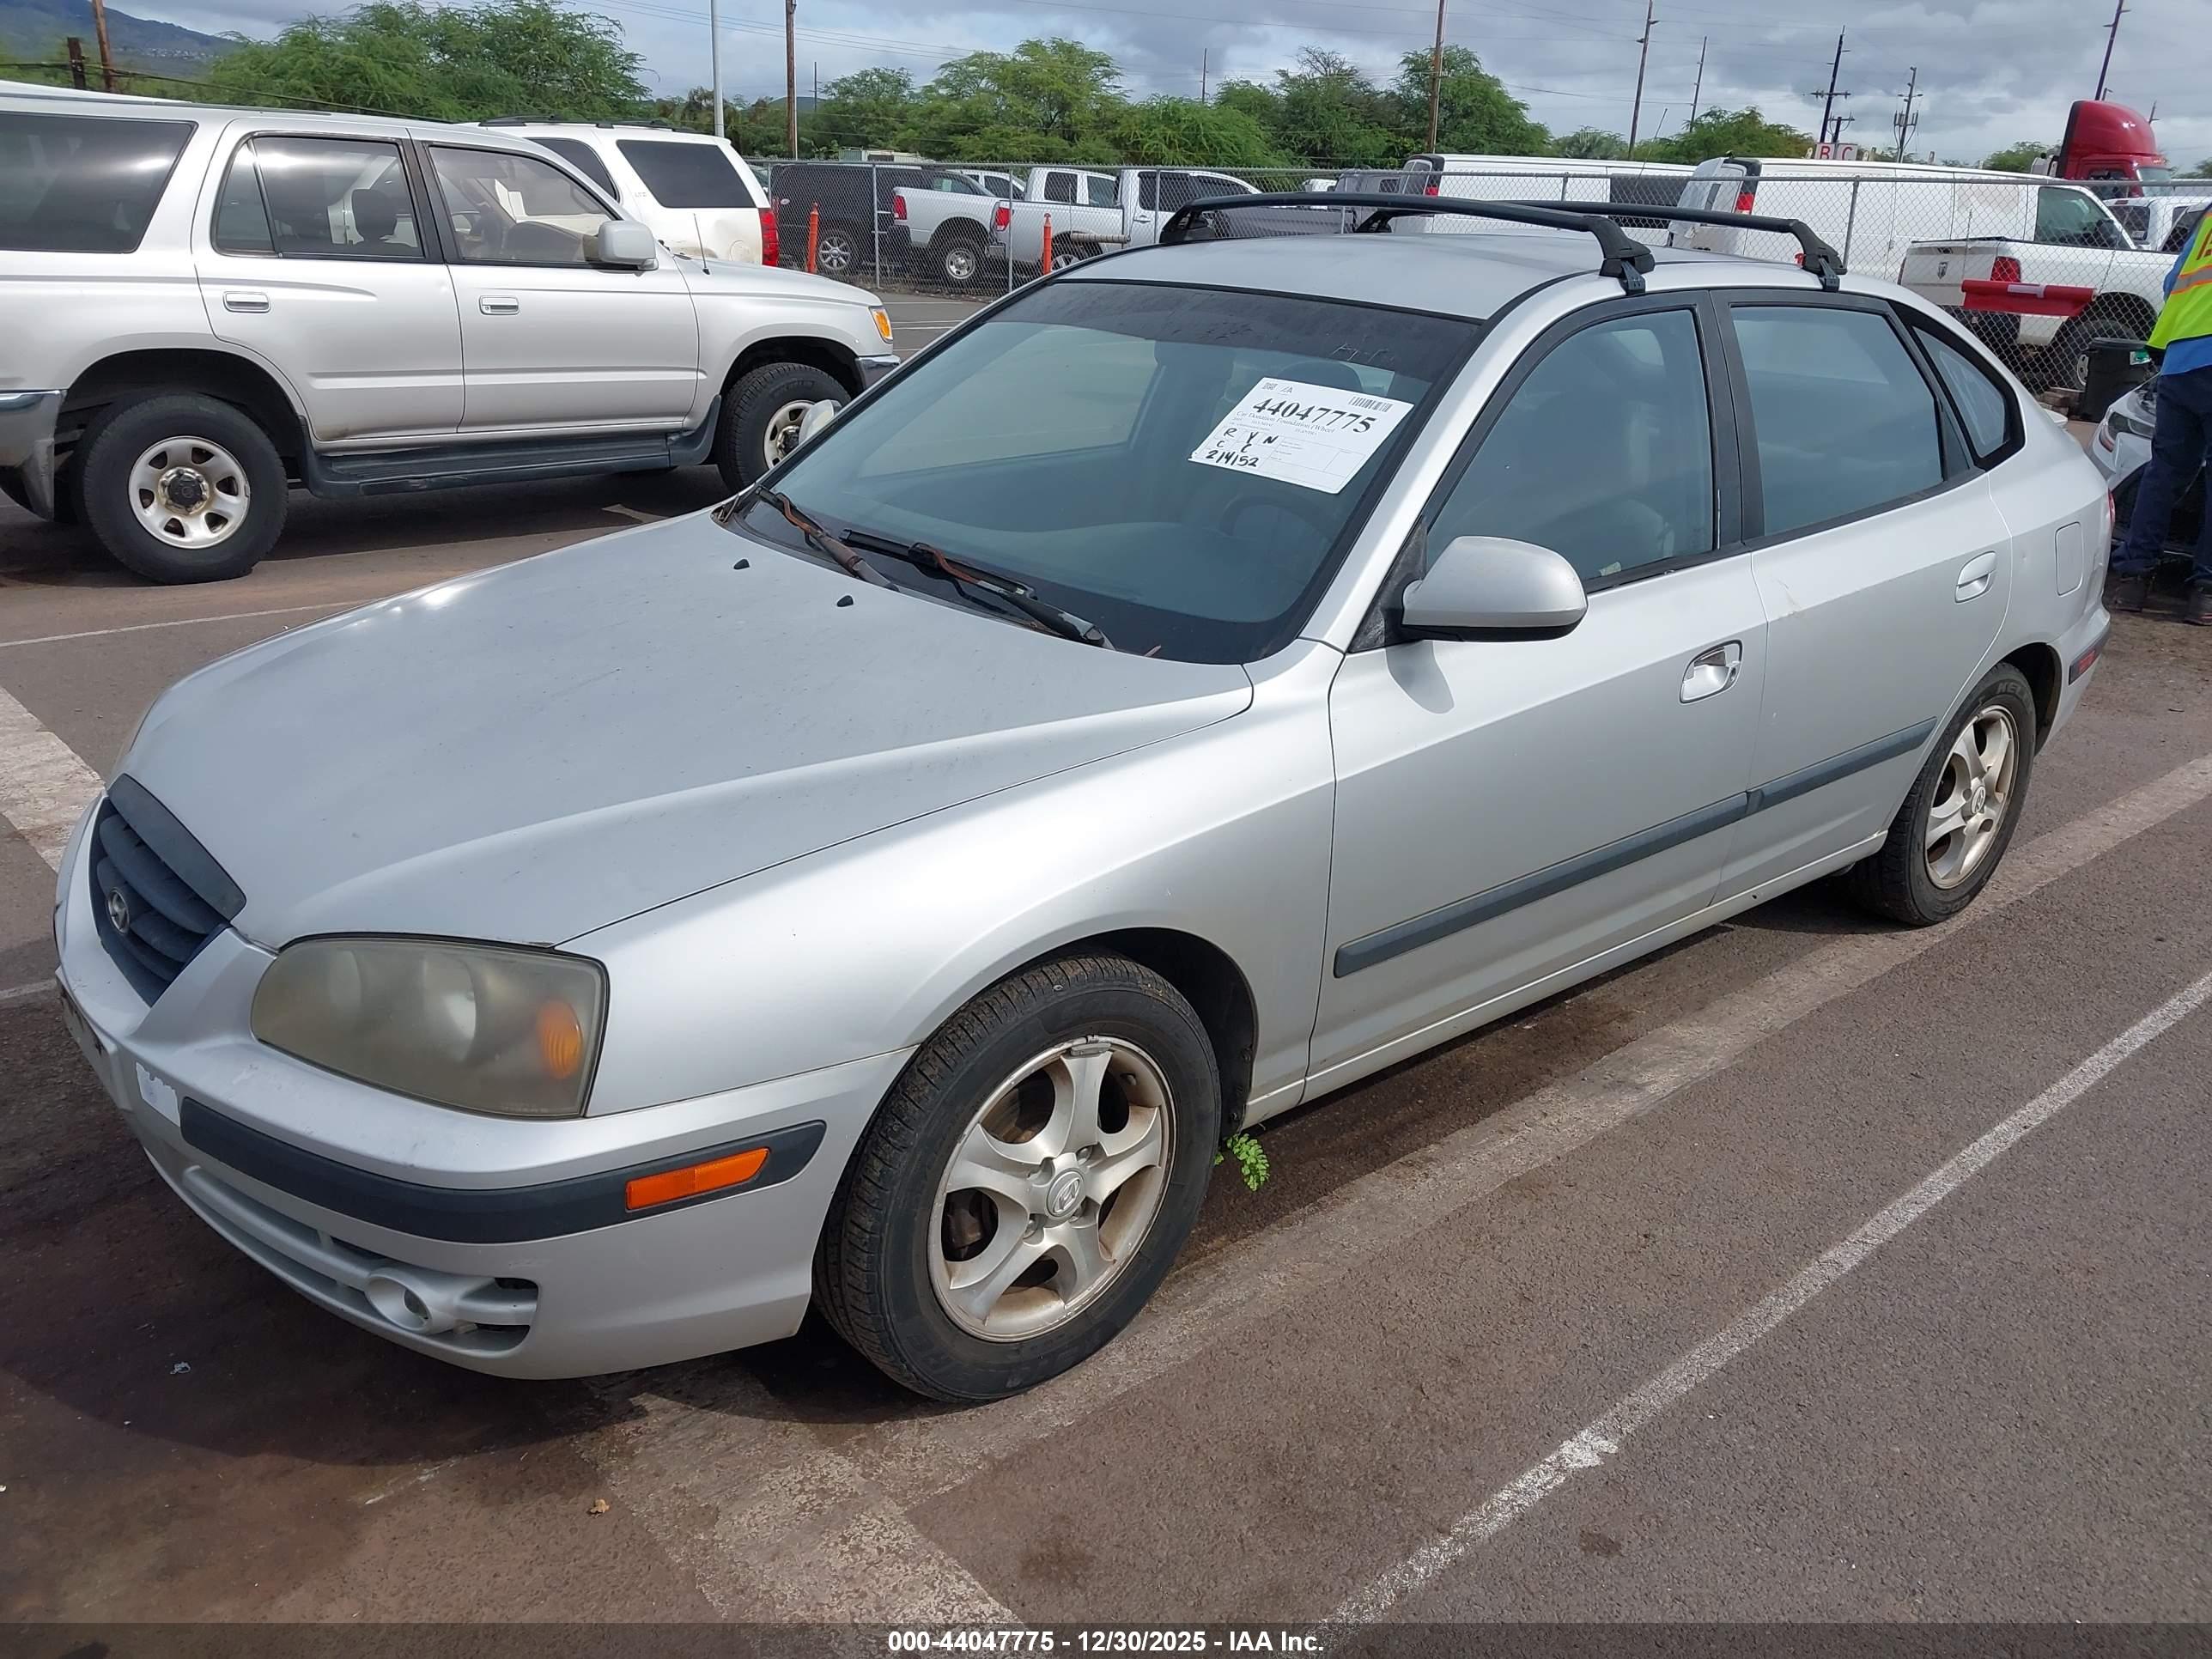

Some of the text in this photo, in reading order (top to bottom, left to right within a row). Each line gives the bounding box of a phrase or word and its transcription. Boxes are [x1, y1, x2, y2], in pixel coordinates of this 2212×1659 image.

[1252, 398, 1378, 434] 44047775
[1276, 416, 1311, 428] Foundation
[1223, 428, 1237, 438] R
[1262, 434, 1279, 444] N
